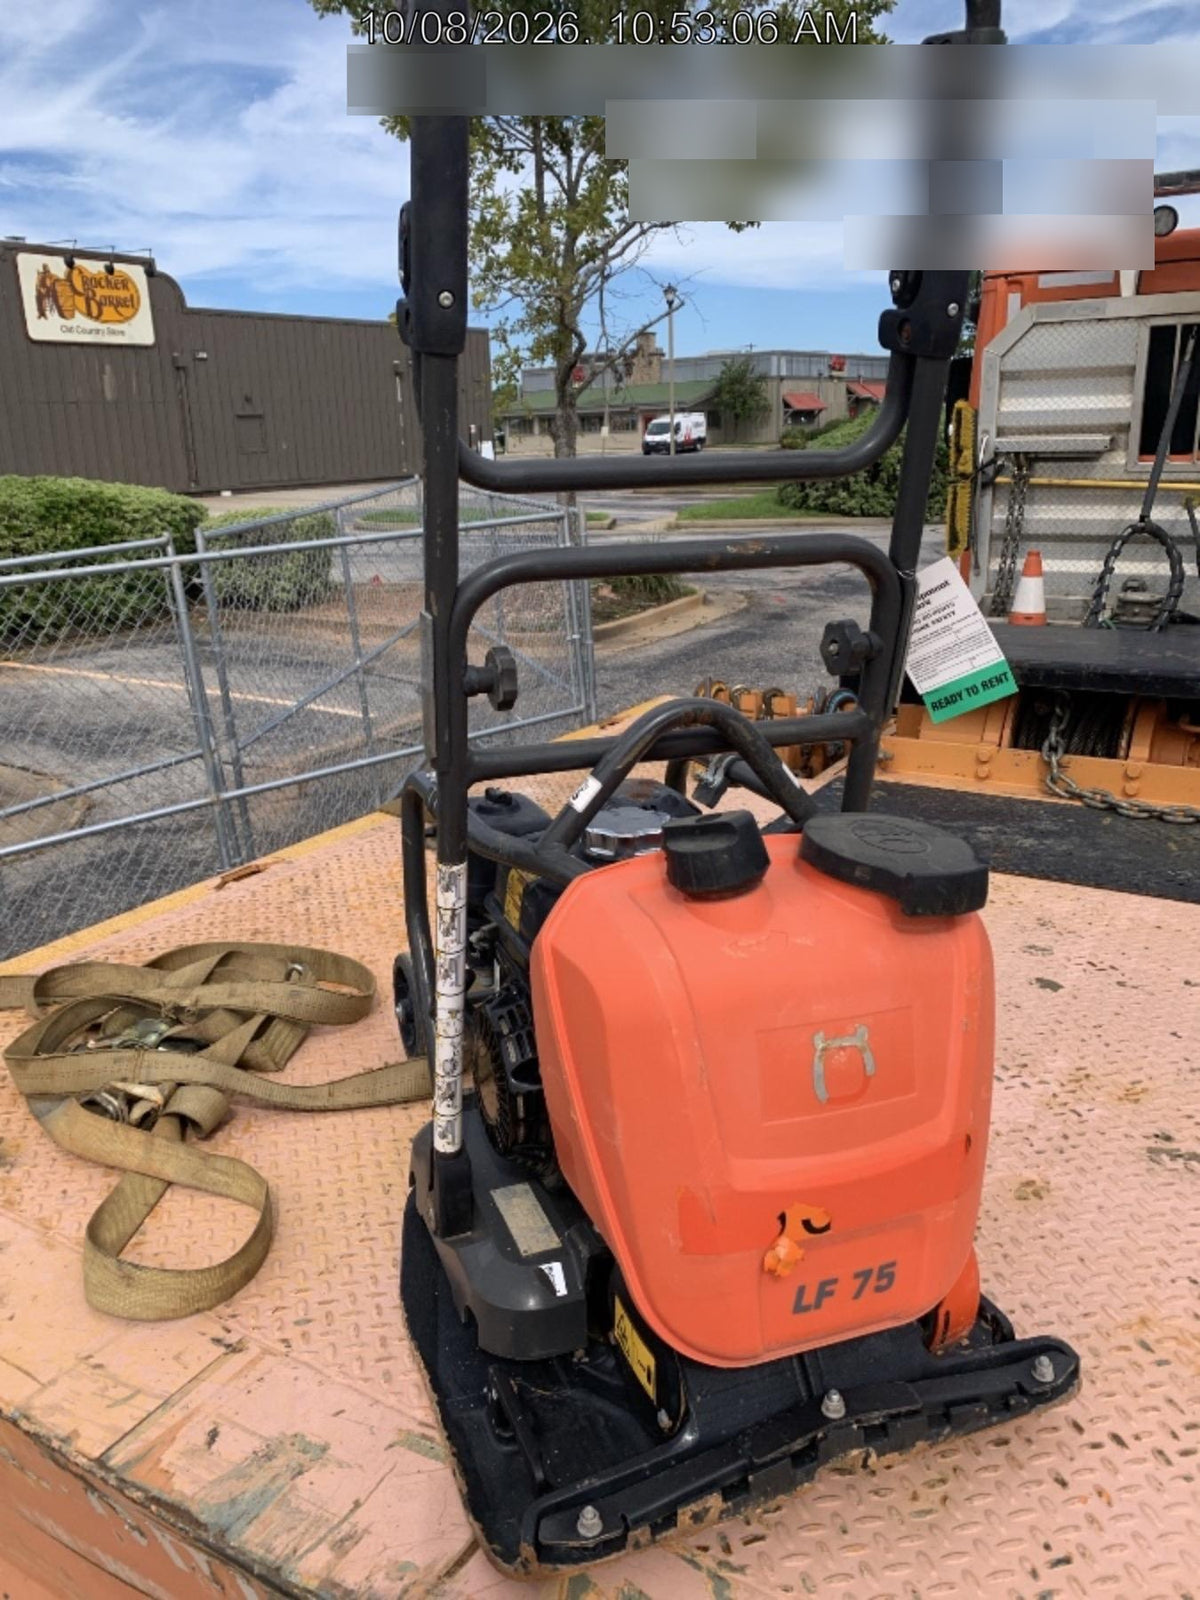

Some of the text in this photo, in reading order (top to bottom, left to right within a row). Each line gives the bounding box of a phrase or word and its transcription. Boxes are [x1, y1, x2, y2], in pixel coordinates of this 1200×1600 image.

[84, 288, 135, 320] Barrel
[931, 671, 1010, 712] READY TO RENT
[792, 1260, 897, 1315] LF 75
